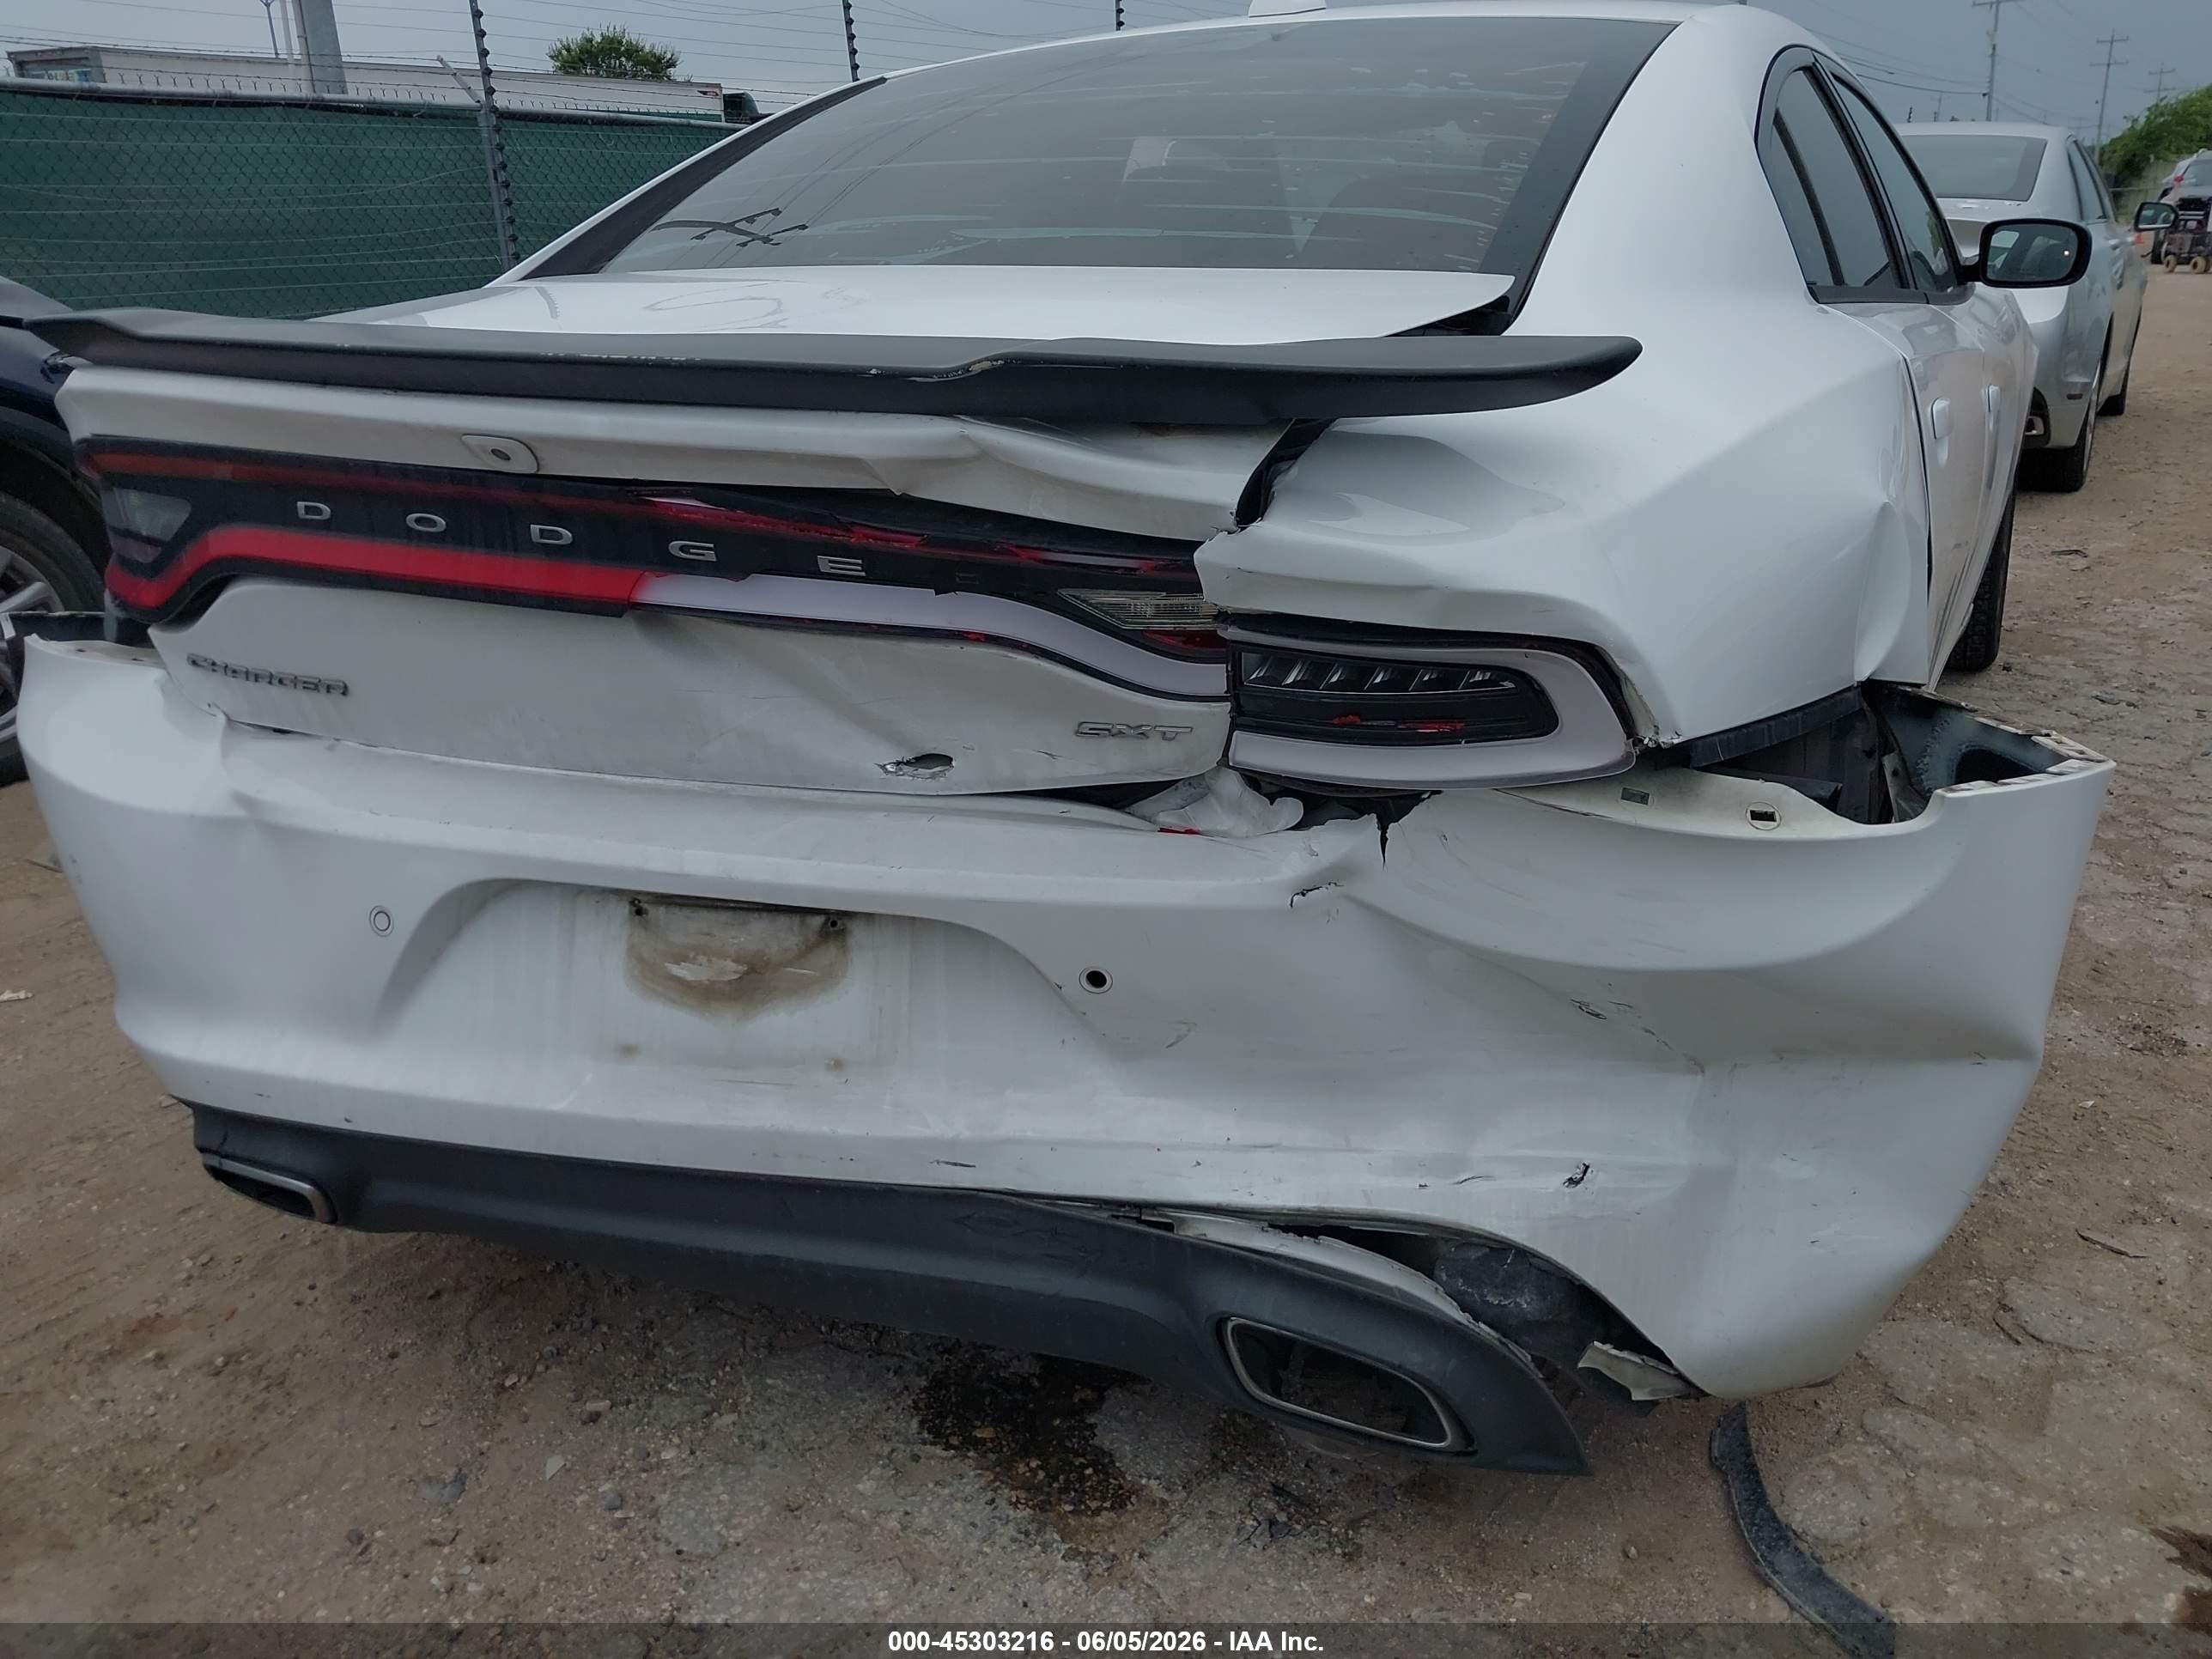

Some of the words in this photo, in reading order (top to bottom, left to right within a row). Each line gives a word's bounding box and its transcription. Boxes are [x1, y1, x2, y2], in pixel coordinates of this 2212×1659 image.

[296, 501, 866, 577] DODGE
[186, 653, 349, 696] CHARGER
[1076, 721, 1194, 741] SXT
